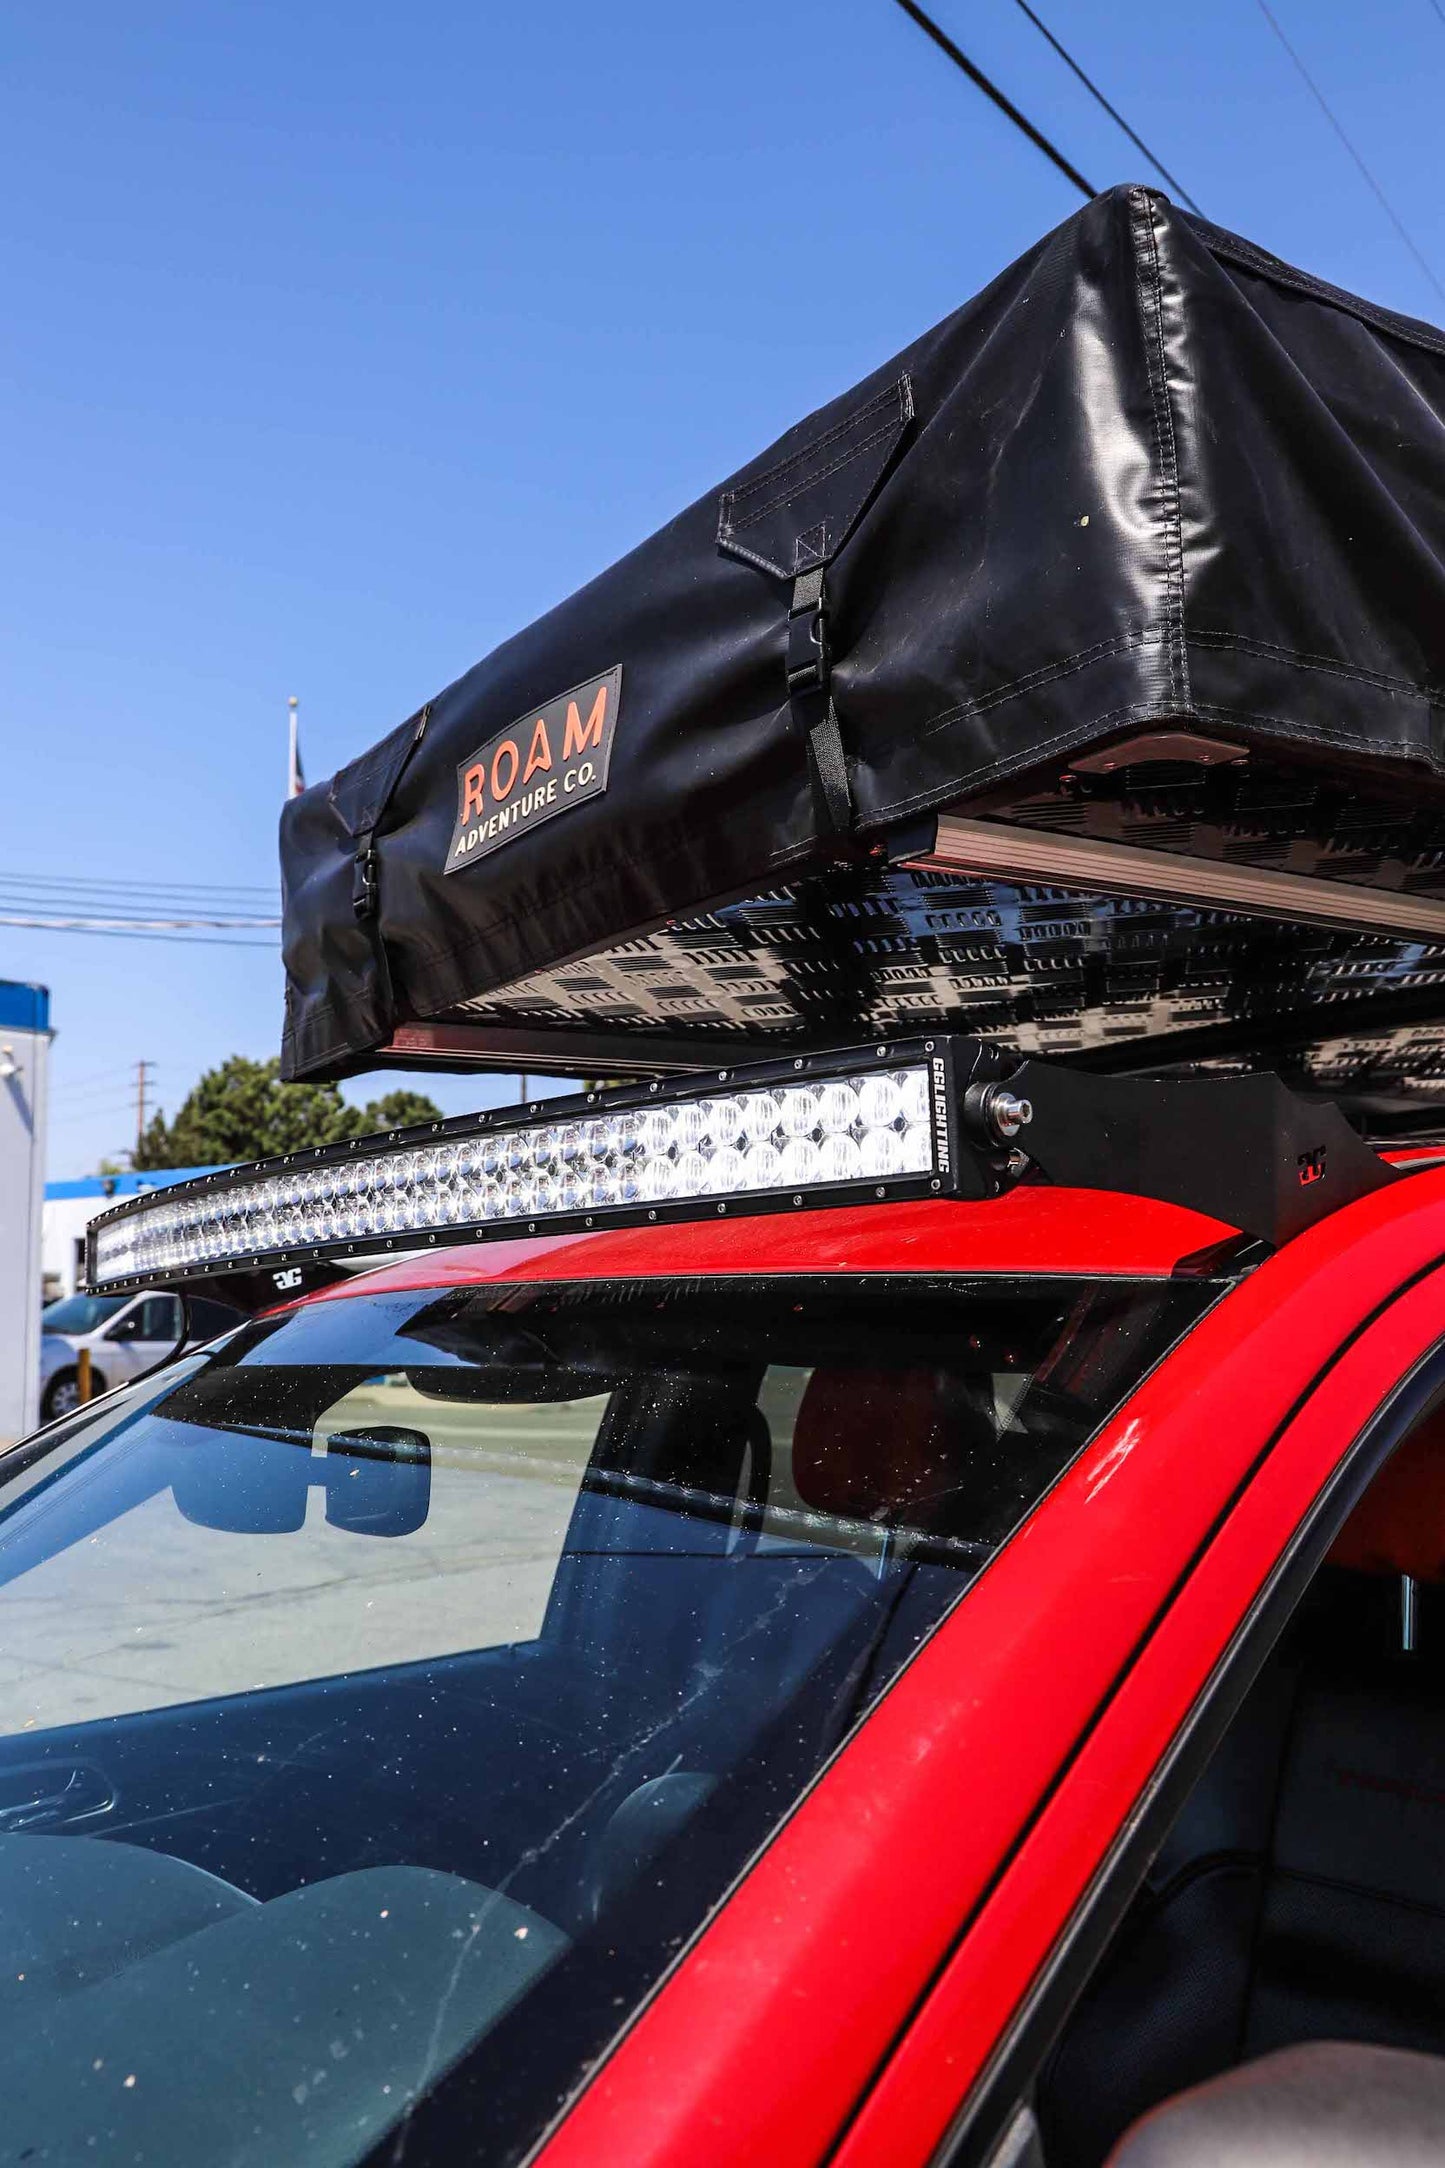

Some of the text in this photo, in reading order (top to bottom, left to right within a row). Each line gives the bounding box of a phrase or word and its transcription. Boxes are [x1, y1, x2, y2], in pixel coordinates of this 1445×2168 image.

[454, 761, 597, 858] ADVENTURE CO.
[461, 686, 607, 827] ROAM
